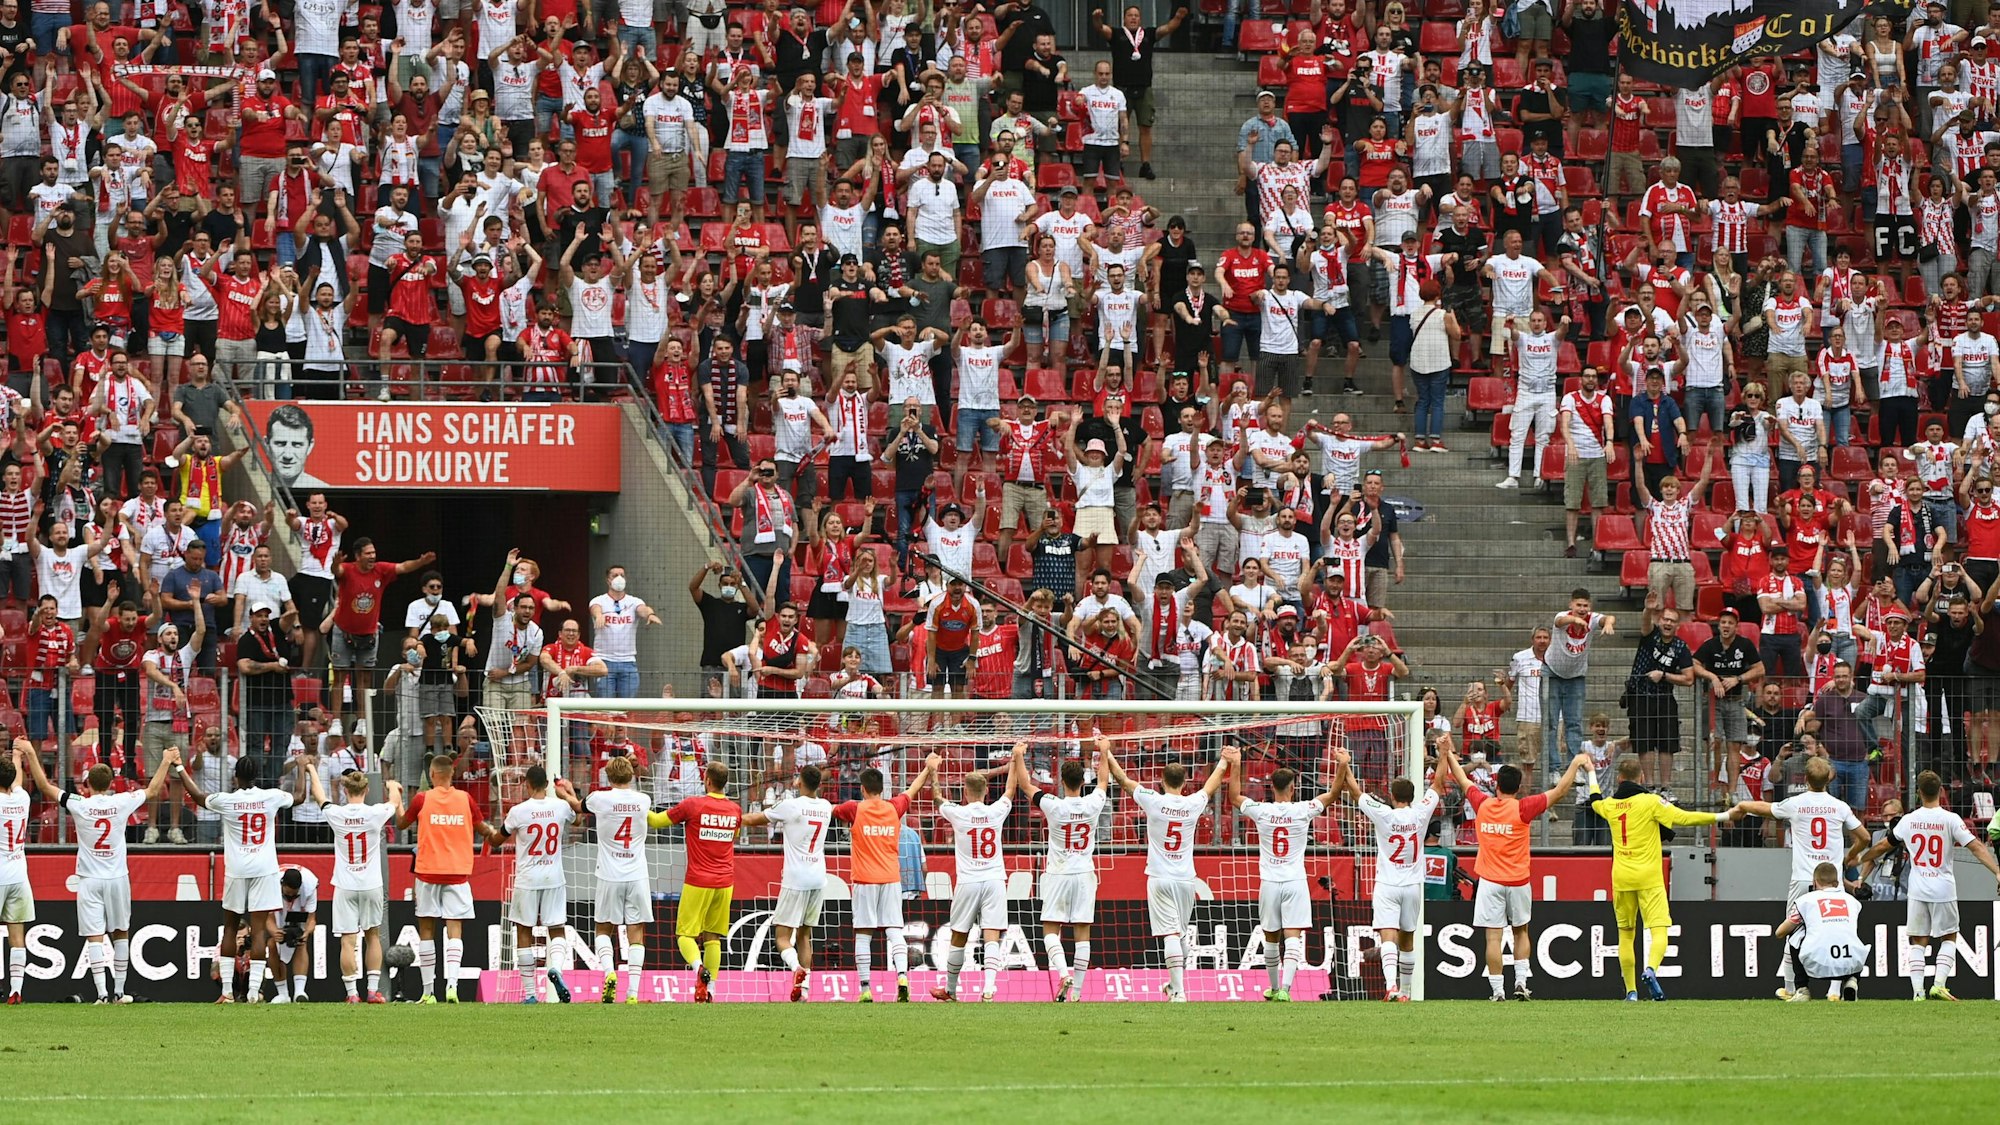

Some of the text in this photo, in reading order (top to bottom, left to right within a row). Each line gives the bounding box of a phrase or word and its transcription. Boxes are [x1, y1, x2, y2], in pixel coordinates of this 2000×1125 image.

[1373, 65, 1393, 73] EWE
[1972, 77, 1994, 86] REWE
[948, 94, 972, 102] REWE
[1091, 101, 1117, 109] REWE
[1795, 105, 1818, 114] REWE
[582, 128, 607, 137] REWE
[1367, 151, 1392, 160] REWE
[1958, 147, 1983, 156] REWE
[41, 201, 63, 209] REW
[1387, 202, 1412, 210] REWE
[1722, 213, 1744, 222] REWE
[1336, 219, 1360, 228] REWE
[1052, 226, 1079, 235] REWE
[734, 238, 760, 246] REWE
[1234, 268, 1259, 277] REWE
[1502, 270, 1527, 279] REWE
[1652, 279, 1672, 288] REW
[1108, 302, 1130, 311] REWE
[1778, 314, 1801, 322] REWE
[1527, 344, 1551, 353] REWE
[1962, 352, 1988, 361] REWE
[968, 357, 992, 366] REWE
[357, 406, 574, 445] HANS SCHÄFER
[1791, 417, 1816, 426] REWE
[1261, 447, 1287, 456] REWE
[1331, 451, 1356, 459] REWE
[356, 445, 510, 483] SÜDKURVE
[1976, 512, 1998, 520] REWE
[1045, 546, 1070, 554] REWE
[1334, 548, 1359, 557] REWE
[1738, 546, 1761, 556] REWE
[1274, 551, 1300, 559] REWE
[605, 616, 631, 624] REWE
[976, 643, 1002, 657] REWE
[233, 800, 266, 810] EHIZIBUE
[612, 803, 641, 812] HÜBERS
[2, 806, 24, 815] HECTOR
[88, 807, 118, 816] SCHMITZ
[530, 810, 555, 820] SKHIRI
[1160, 806, 1190, 818] CZICHOS
[1797, 806, 1836, 815] ANDERSSON
[344, 816, 364, 826] KAINZ
[430, 814, 464, 826] REWE
[700, 814, 736, 828] REWE
[1270, 814, 1292, 825] ÖZCAN
[238, 813, 266, 845] 19
[863, 825, 895, 837] REWE
[1391, 822, 1418, 832] SCHAUB
[1480, 822, 1513, 834] REWE
[1618, 812, 1628, 846] 1
[1910, 822, 1945, 832] THIELMANN
[4, 818, 26, 852] 14
[94, 818, 111, 850] 2
[614, 816, 632, 849] 4
[808, 820, 823, 853] 7
[1060, 822, 1090, 850] 13
[1164, 822, 1182, 852] 5
[1811, 817, 1827, 850] 9
[528, 822, 558, 856] 28
[966, 827, 996, 859] 18
[1272, 826, 1289, 857] 6
[344, 832, 366, 864] 11
[1388, 834, 1419, 865] 21
[1910, 834, 1943, 868] 29
[1830, 944, 1852, 958] 01
